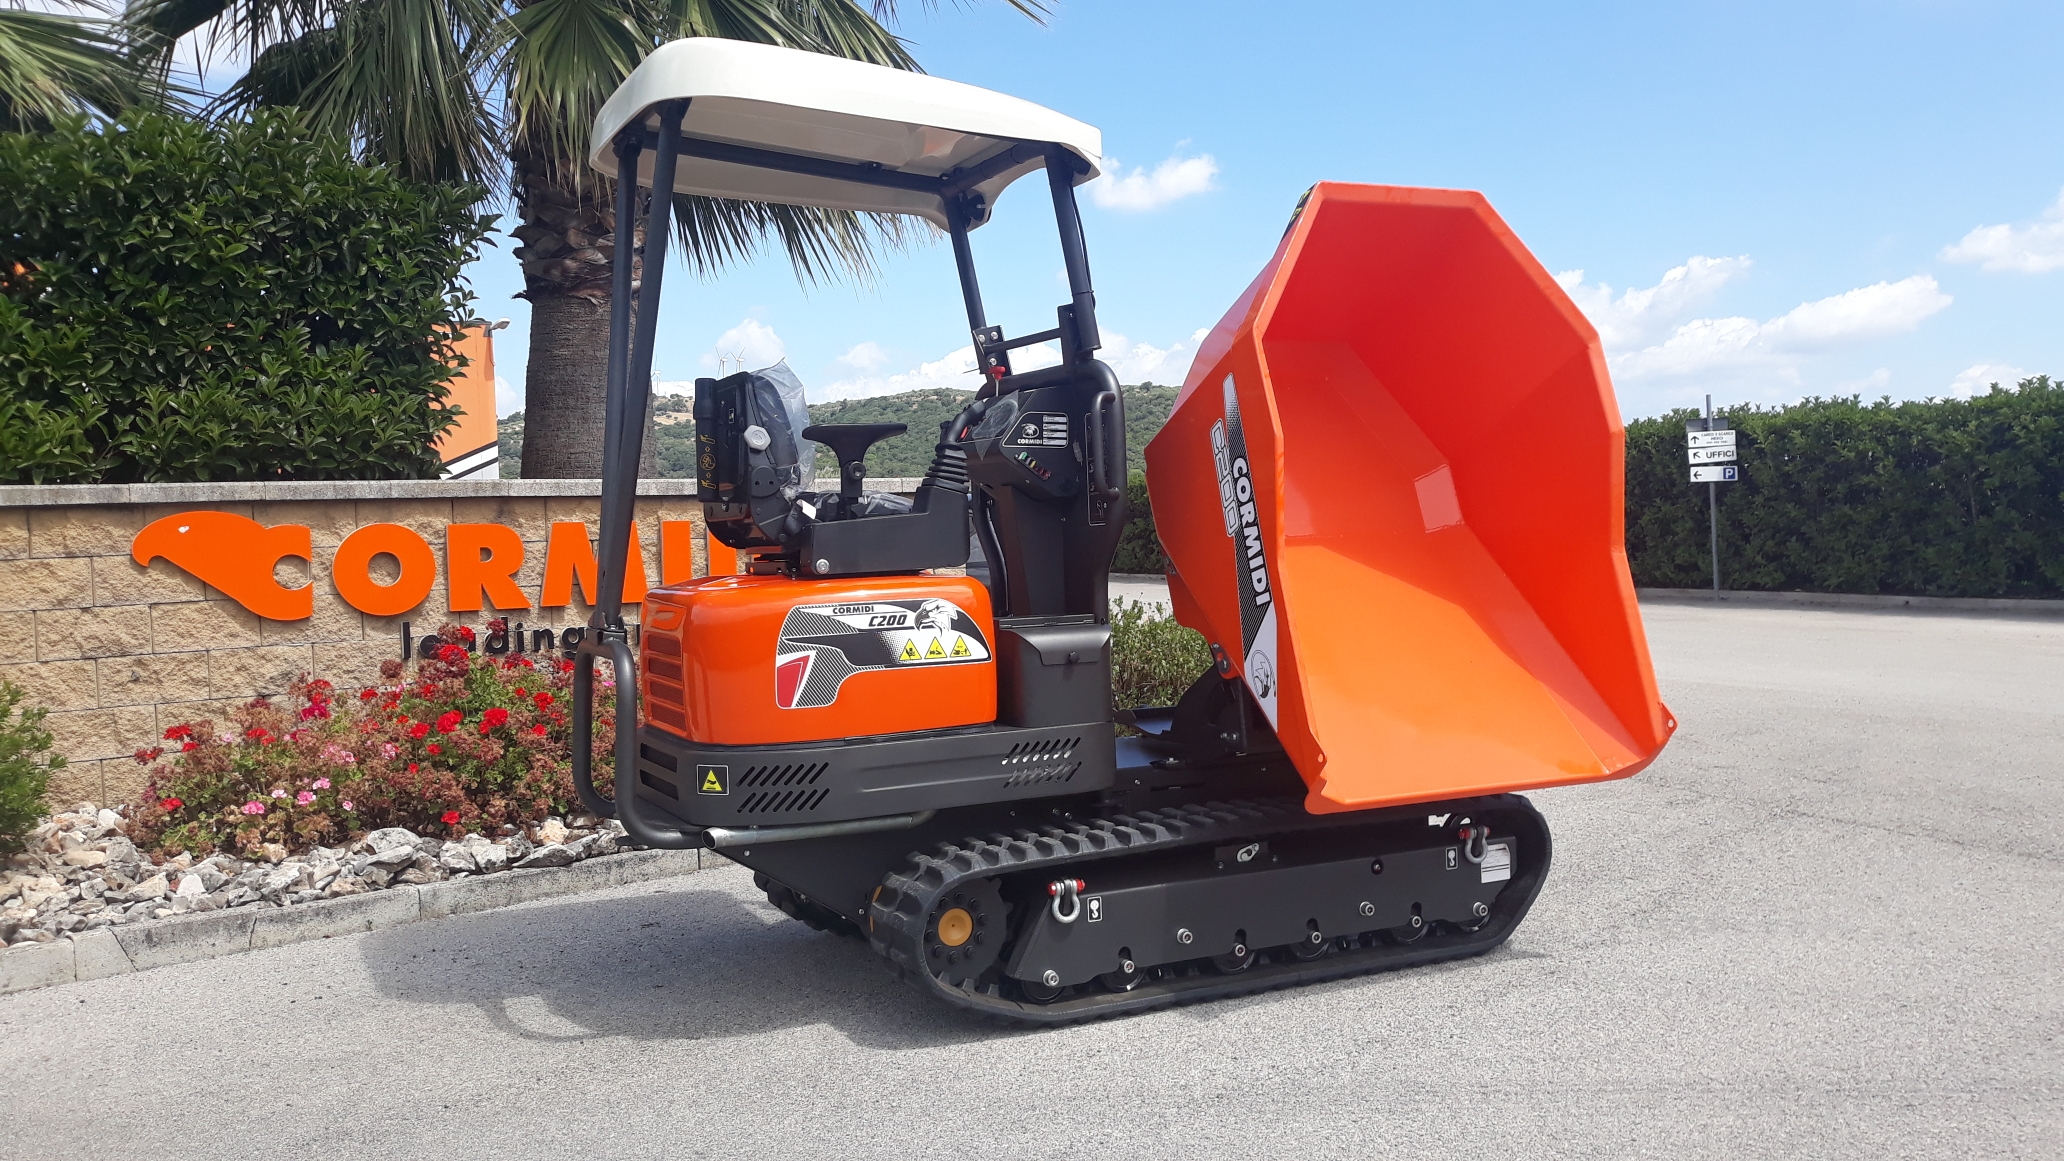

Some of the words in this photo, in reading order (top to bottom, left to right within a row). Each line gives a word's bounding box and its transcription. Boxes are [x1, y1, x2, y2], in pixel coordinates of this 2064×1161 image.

[1705, 450, 1734, 458] UFFICI
[1725, 468, 1734, 479] P
[1233, 458, 1271, 606] CORMIDI
[131, 510, 738, 621] CORMI
[832, 605, 874, 614] CORMIDI
[868, 614, 908, 627] C200
[401, 616, 591, 660] leding
